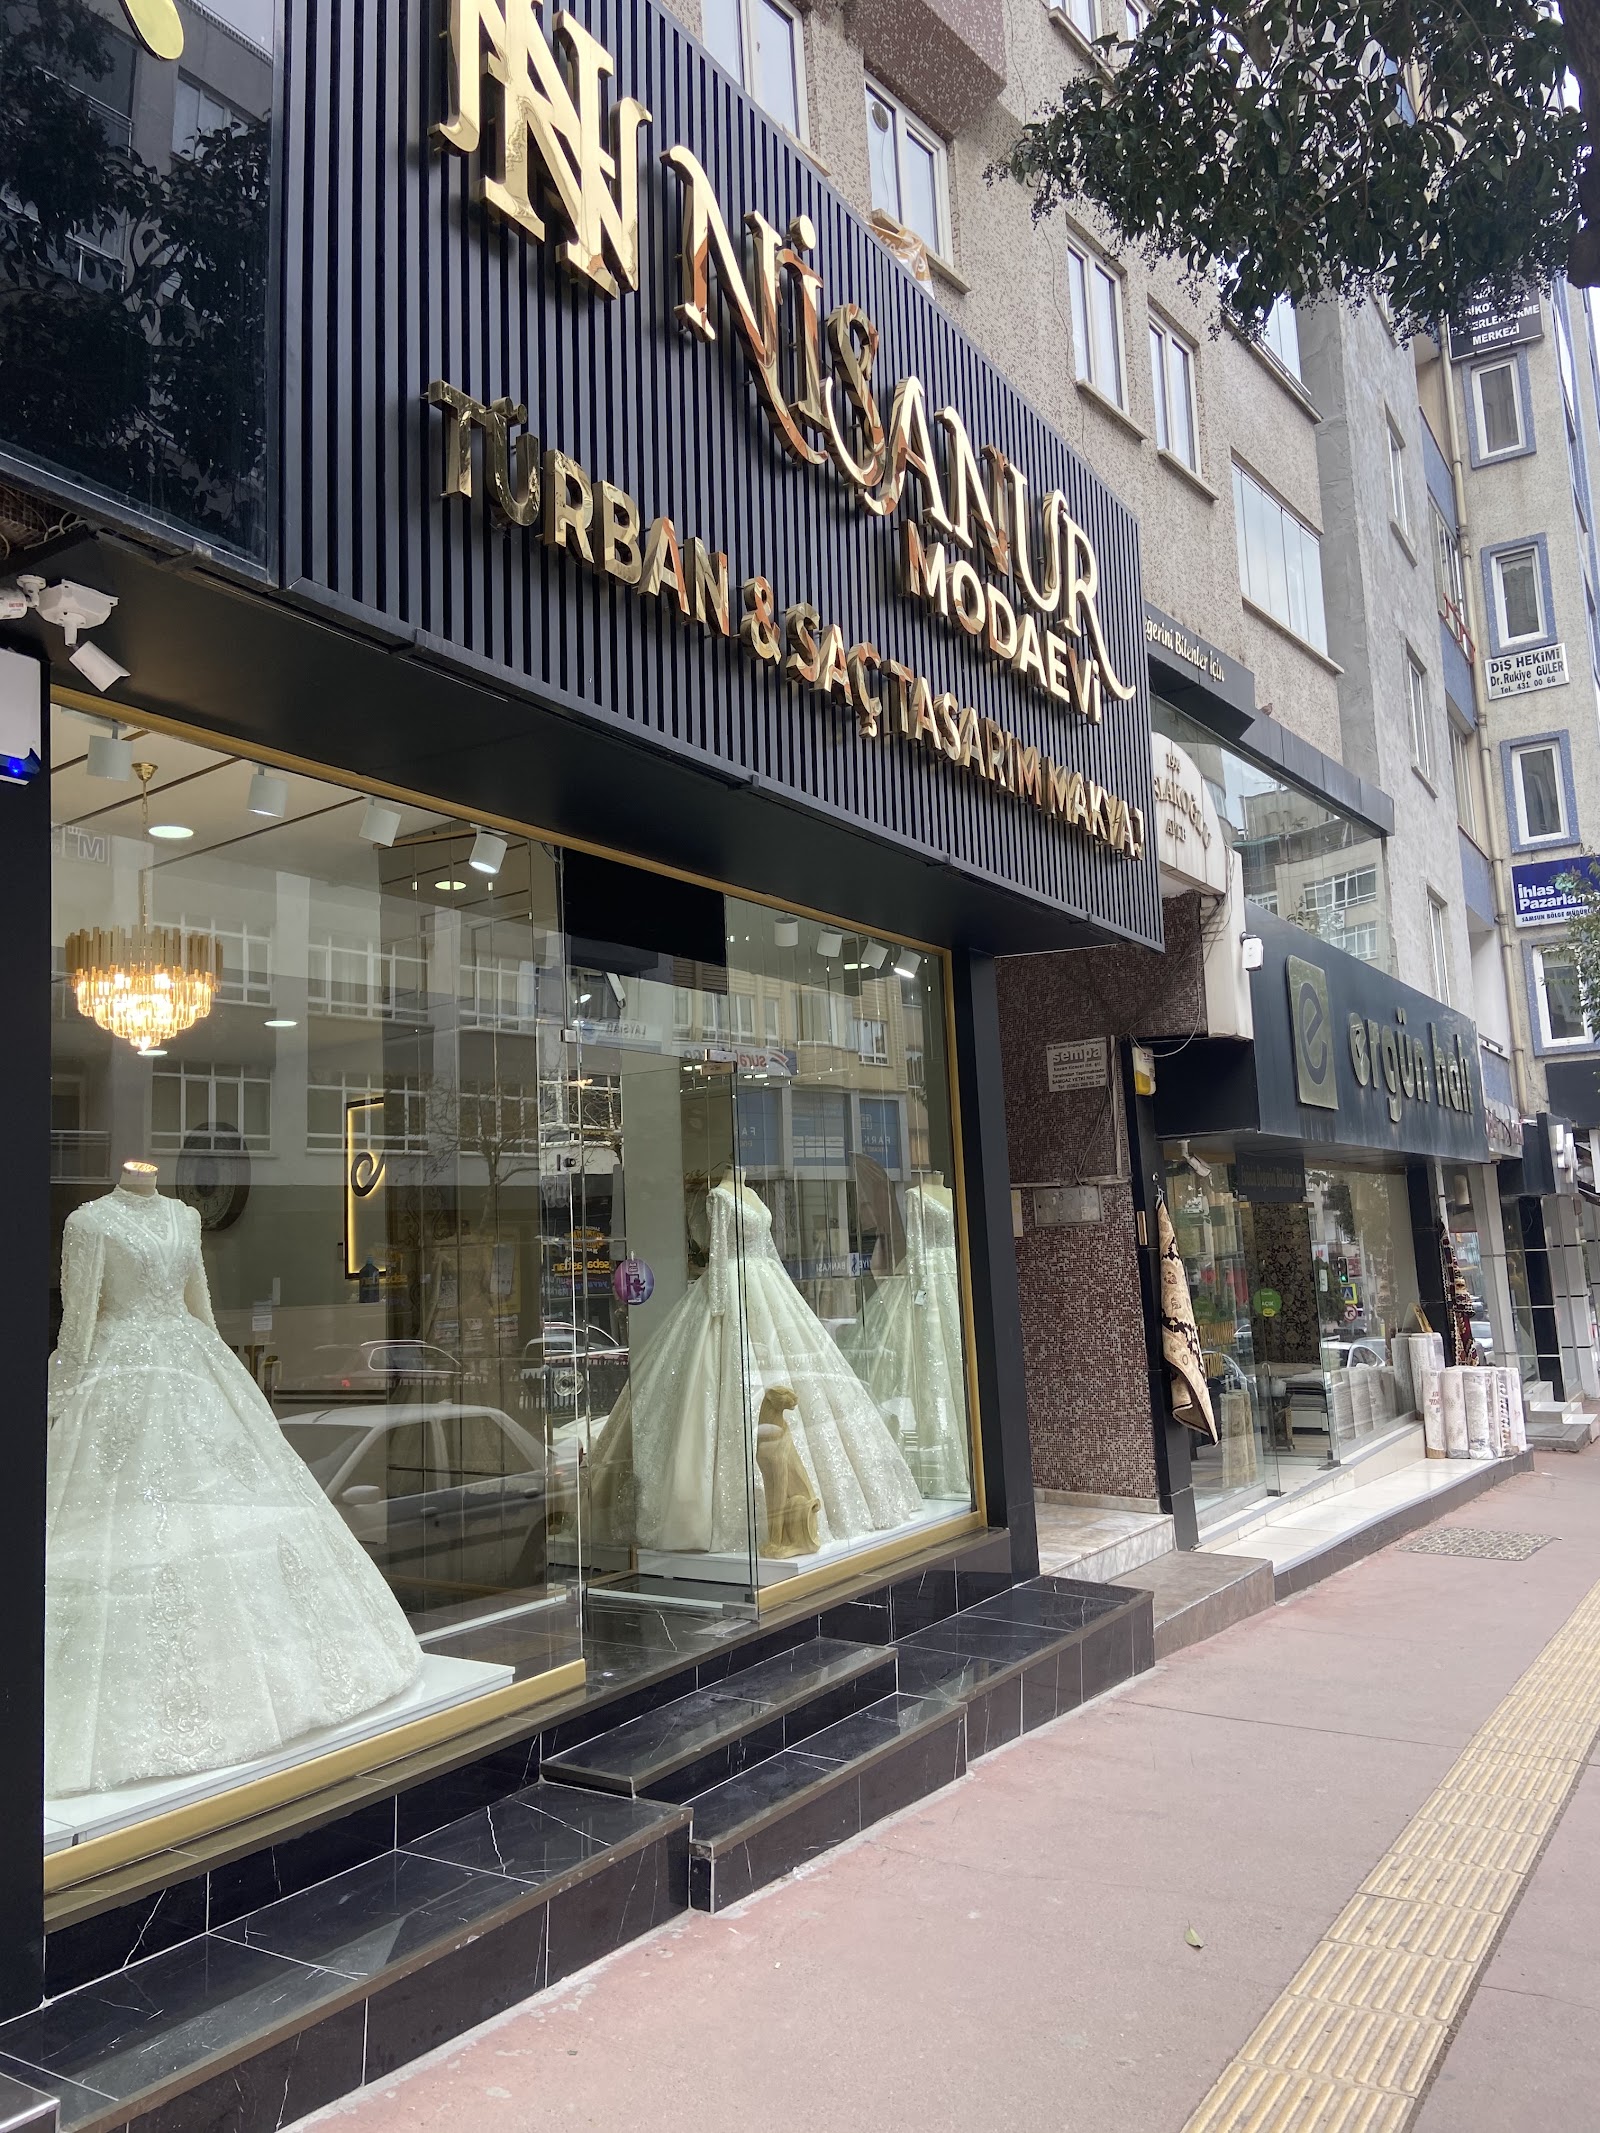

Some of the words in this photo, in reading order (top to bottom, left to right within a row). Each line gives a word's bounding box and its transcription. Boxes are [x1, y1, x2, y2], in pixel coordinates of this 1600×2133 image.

[428, 379, 730, 637] TÜRBAN
[740, 577, 781, 665] &
[786, 602, 881, 738] SAÇ
[1175, 631, 1208, 671] Bilenler
[1053, 1046, 1101, 1067] sempa
[1349, 1006, 1431, 1124] ergün
